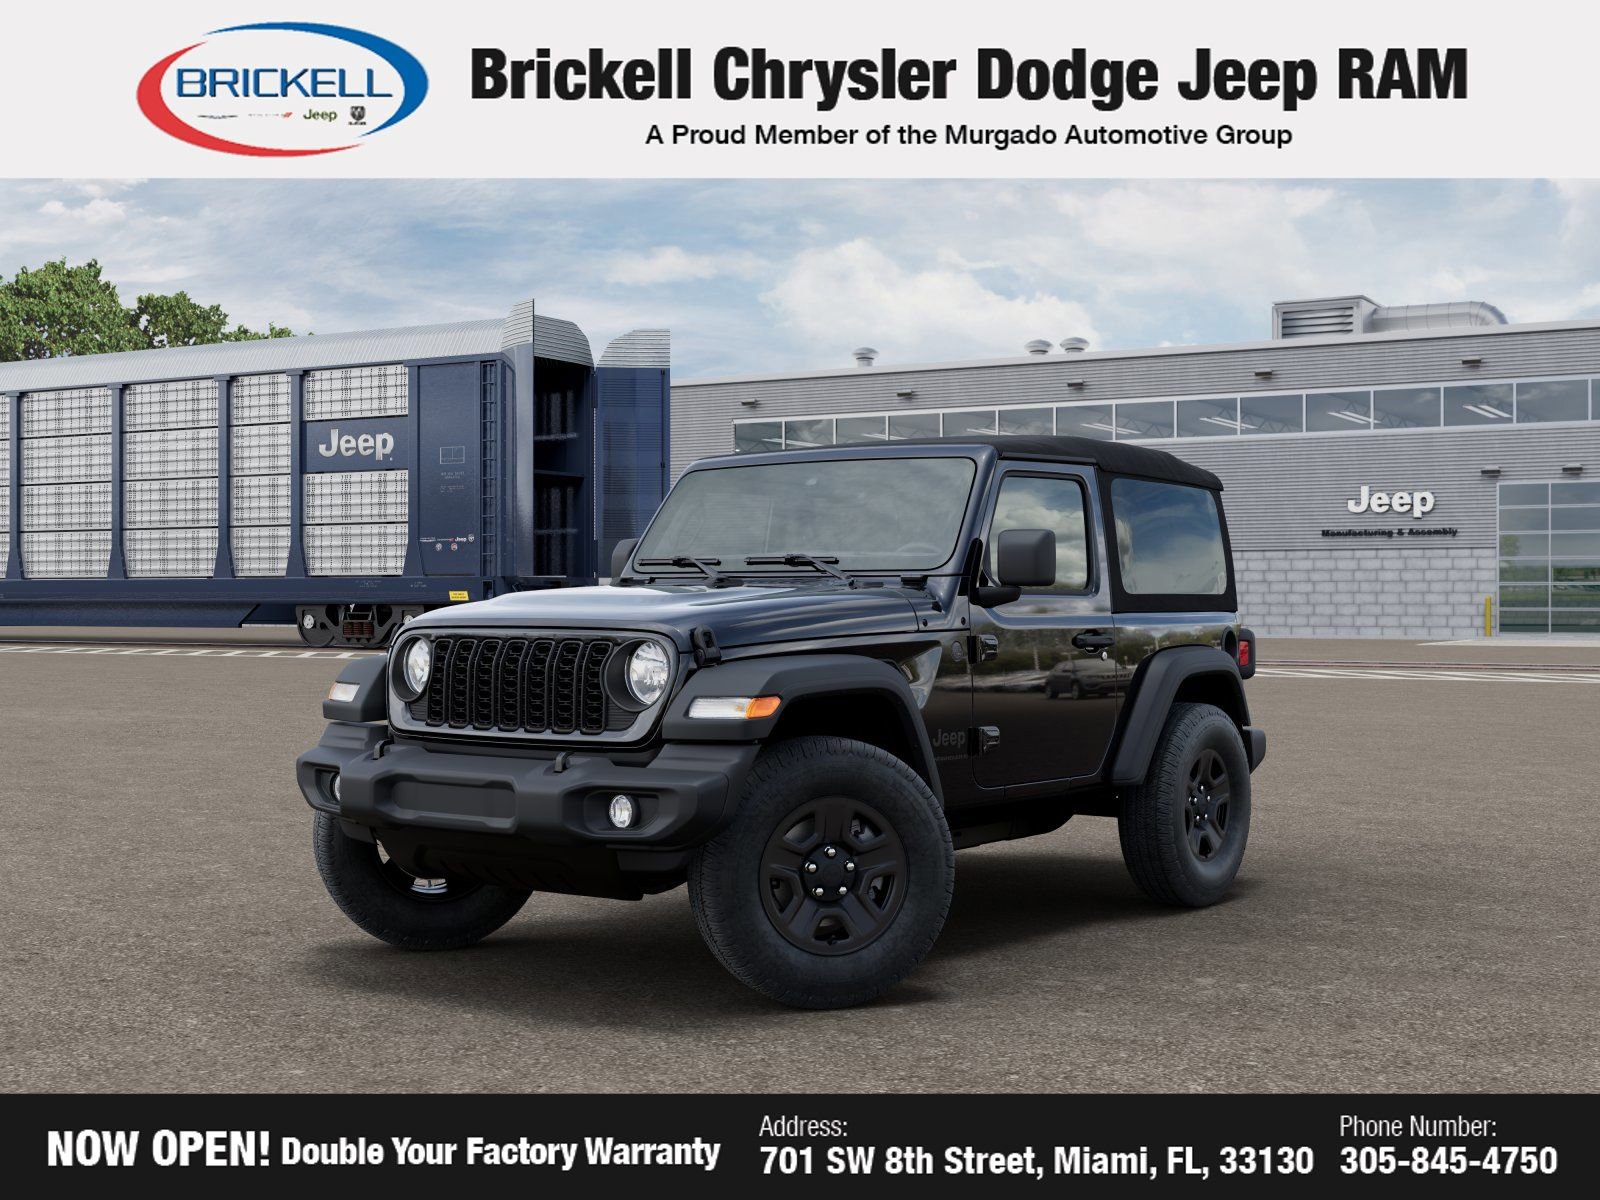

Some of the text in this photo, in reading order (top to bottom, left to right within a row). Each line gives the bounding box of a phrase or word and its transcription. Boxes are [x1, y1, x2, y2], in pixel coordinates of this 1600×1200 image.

[318, 428, 395, 462] Jeep
[1347, 485, 1435, 518] Jeep
[1321, 527, 1458, 539] Manufacturing & Assembly
[932, 728, 966, 749] Jeep
